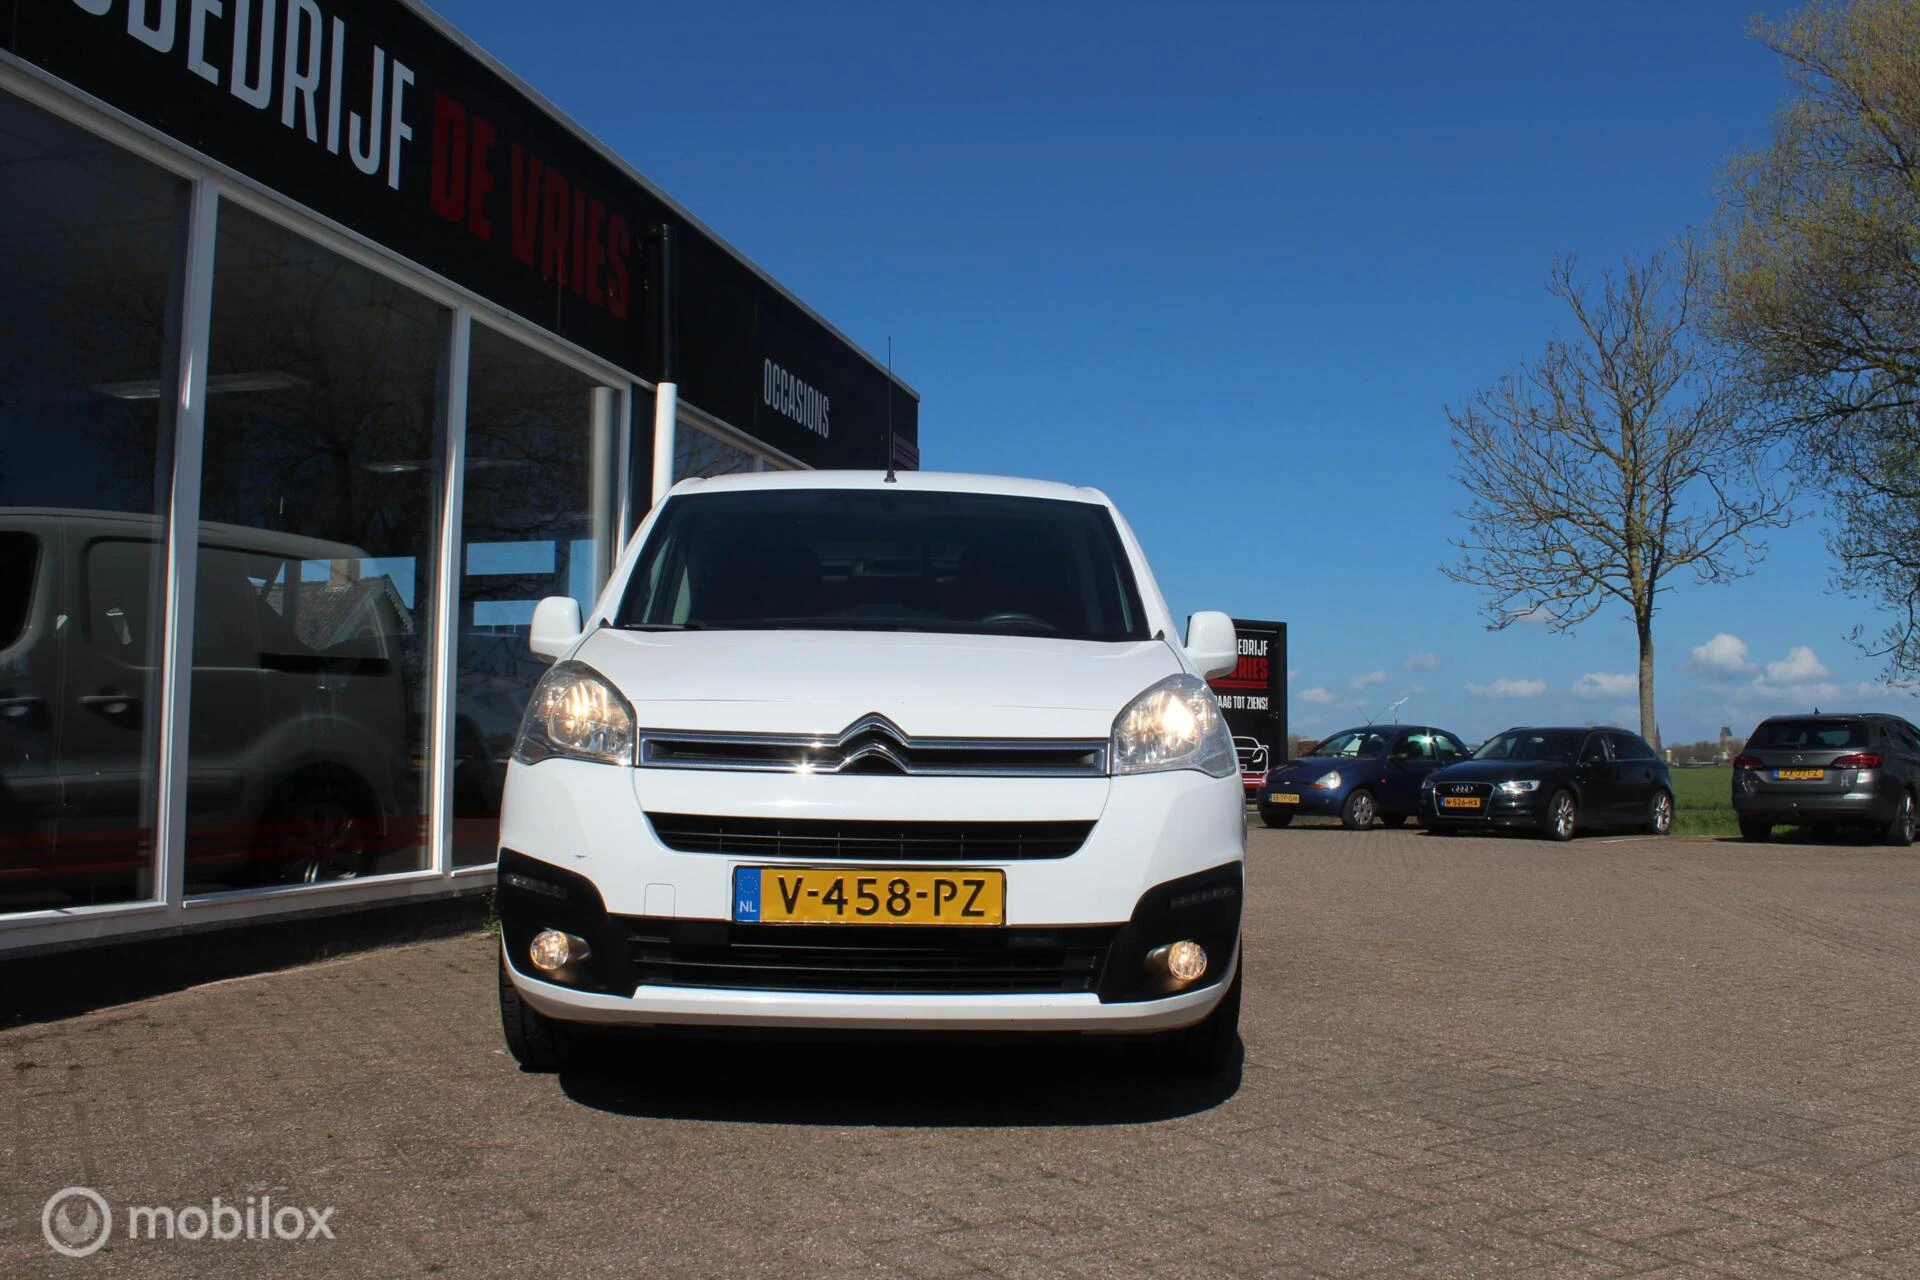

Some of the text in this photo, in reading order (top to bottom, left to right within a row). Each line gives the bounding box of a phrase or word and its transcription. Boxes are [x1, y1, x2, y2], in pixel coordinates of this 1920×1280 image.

[73, 0, 631, 319] EDRIJF DE VRIES
[763, 358, 829, 439] OCCASIONS
[1238, 638, 1269, 656] EDRIJF
[1231, 656, 1269, 680] RIES
[1233, 696, 1245, 709] TOT
[1246, 696, 1269, 710] ZIENS!
[739, 900, 757, 913] NL
[777, 876, 986, 917] V-458-PZ
